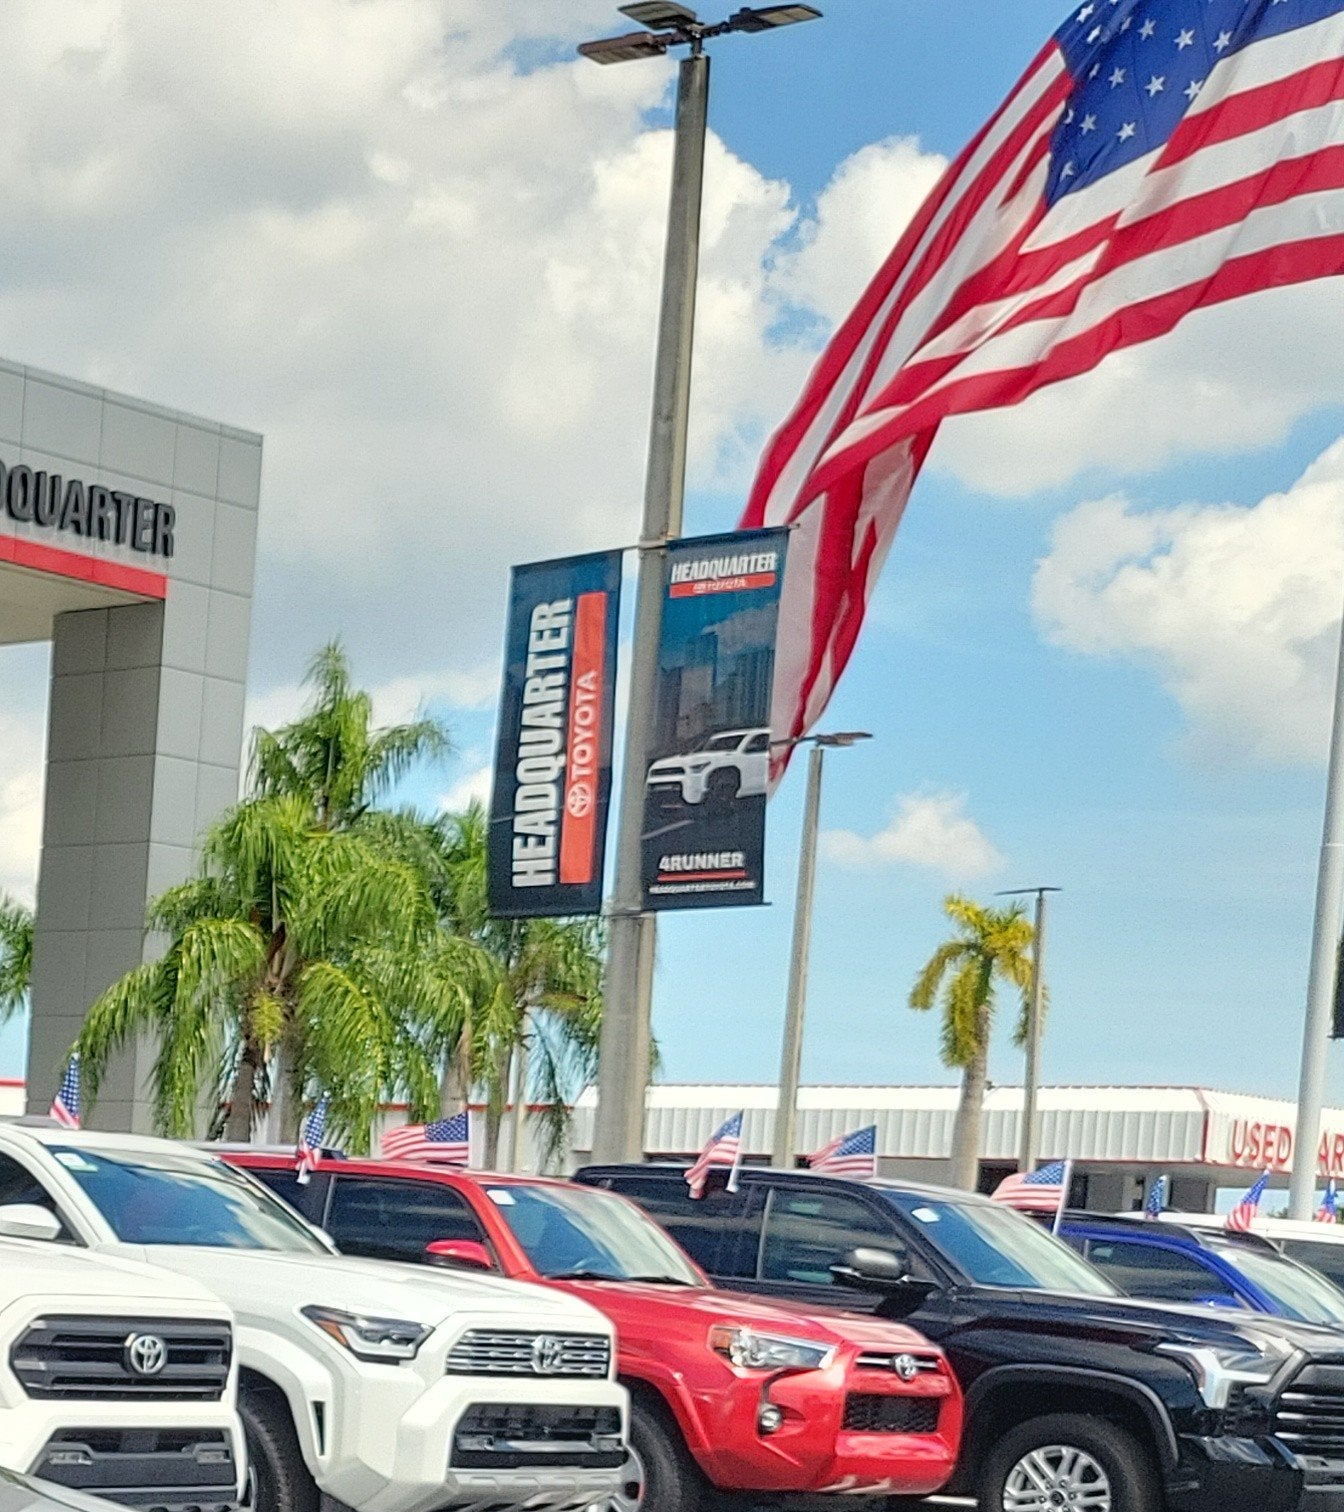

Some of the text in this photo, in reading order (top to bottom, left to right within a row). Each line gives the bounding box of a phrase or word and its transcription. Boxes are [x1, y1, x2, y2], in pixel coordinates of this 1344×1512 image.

[671, 553, 776, 583] HEADQUARTER
[512, 597, 573, 888] HEADQUARTER
[571, 670, 598, 782] TOYOTA
[659, 850, 744, 871] 4RUNNER
[1232, 1120, 1344, 1173] USED AR
